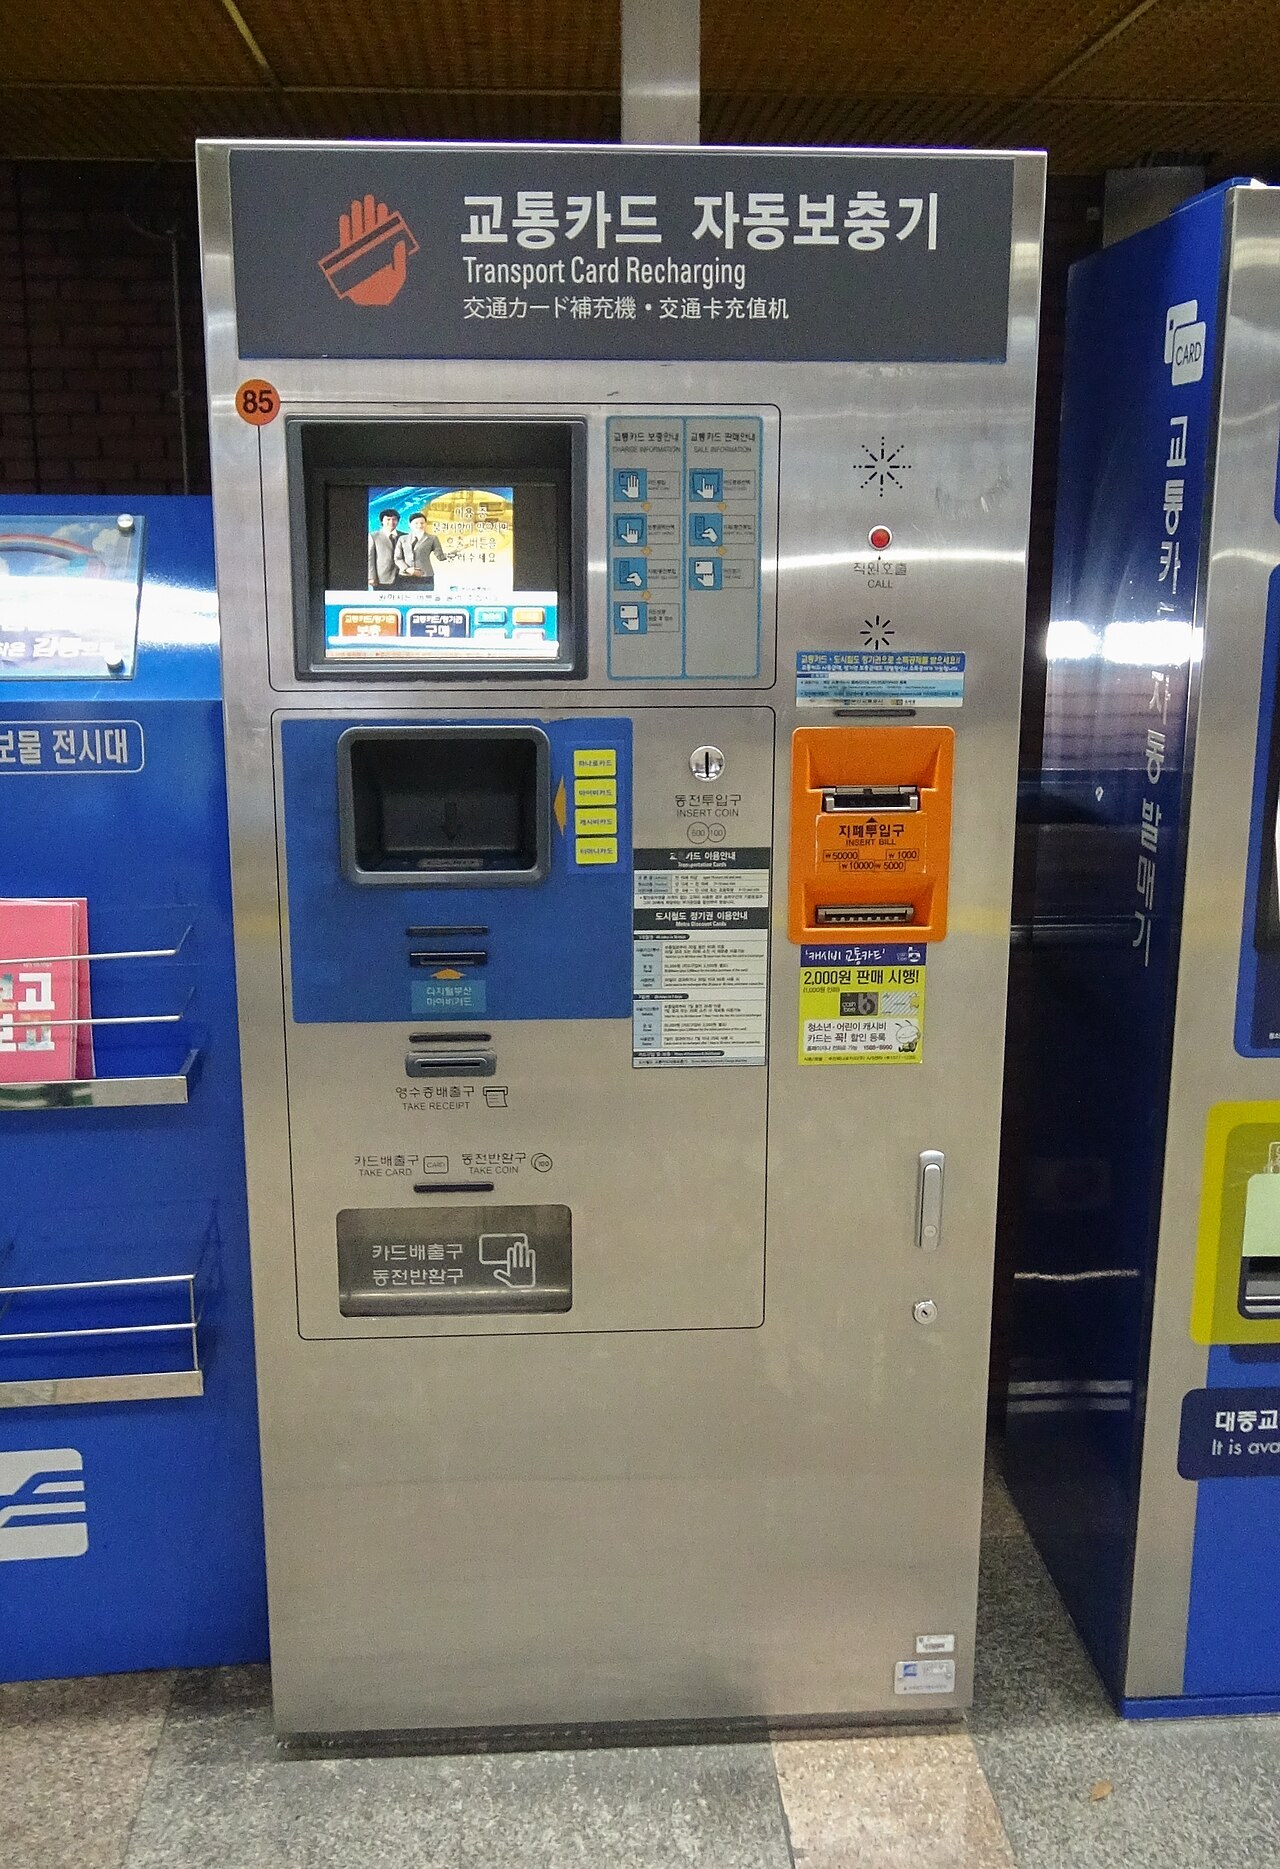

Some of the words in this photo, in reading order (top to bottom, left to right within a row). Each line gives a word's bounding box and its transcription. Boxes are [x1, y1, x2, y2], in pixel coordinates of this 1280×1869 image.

[461, 191, 662, 249] 교통카드
[691, 191, 938, 250] 자동보충기
[463, 256, 565, 289] Transport
[571, 256, 619, 283] Card
[627, 256, 746, 290] Recharging
[1175, 341, 1202, 366] CARD
[243, 390, 273, 413] 85
[613, 432, 645, 442] 교통카드
[691, 432, 722, 442] 교통카드
[854, 562, 907, 576] 직원호출
[867, 579, 894, 589] CALL
[53, 729, 128, 764] 전시대
[675, 794, 742, 807] 동전투입구
[677, 808, 712, 817] INSERT
[714, 808, 739, 817] COIN
[710, 829, 723, 837] 100
[839, 824, 905, 838] 지폐투입구
[845, 839, 875, 847] INSERT
[878, 838, 897, 846] BILL
[704, 851, 736, 861] 이용안내
[655, 911, 687, 921] 도시철도
[690, 911, 714, 921] 정기권
[716, 911, 748, 920] 이용안내
[803, 970, 852, 985] 2,000원
[856, 969, 884, 984] 판매
[888, 969, 919, 984] 시행!
[807, 1034, 832, 1043] 카드는
[834, 1033, 847, 1043] 꼭!
[850, 1033, 867, 1042] 할인
[395, 1085, 475, 1099] 영수증배출구
[403, 1102, 426, 1111] TAKE
[429, 1101, 470, 1110] RECEIPT
[354, 1155, 419, 1167] 카드배출구
[461, 1152, 527, 1166] 동전반환구
[358, 1168, 382, 1177] TAKE
[385, 1168, 412, 1176] CARD
[468, 1166, 493, 1175] TAKE
[495, 1166, 519, 1174] COIN
[372, 1243, 464, 1261] 카드배출구
[372, 1267, 464, 1287] 동전반환구
[1215, 1409, 1279, 1433] 대중교
[1212, 1439, 1224, 1456] It
[1229, 1438, 1242, 1456] is
